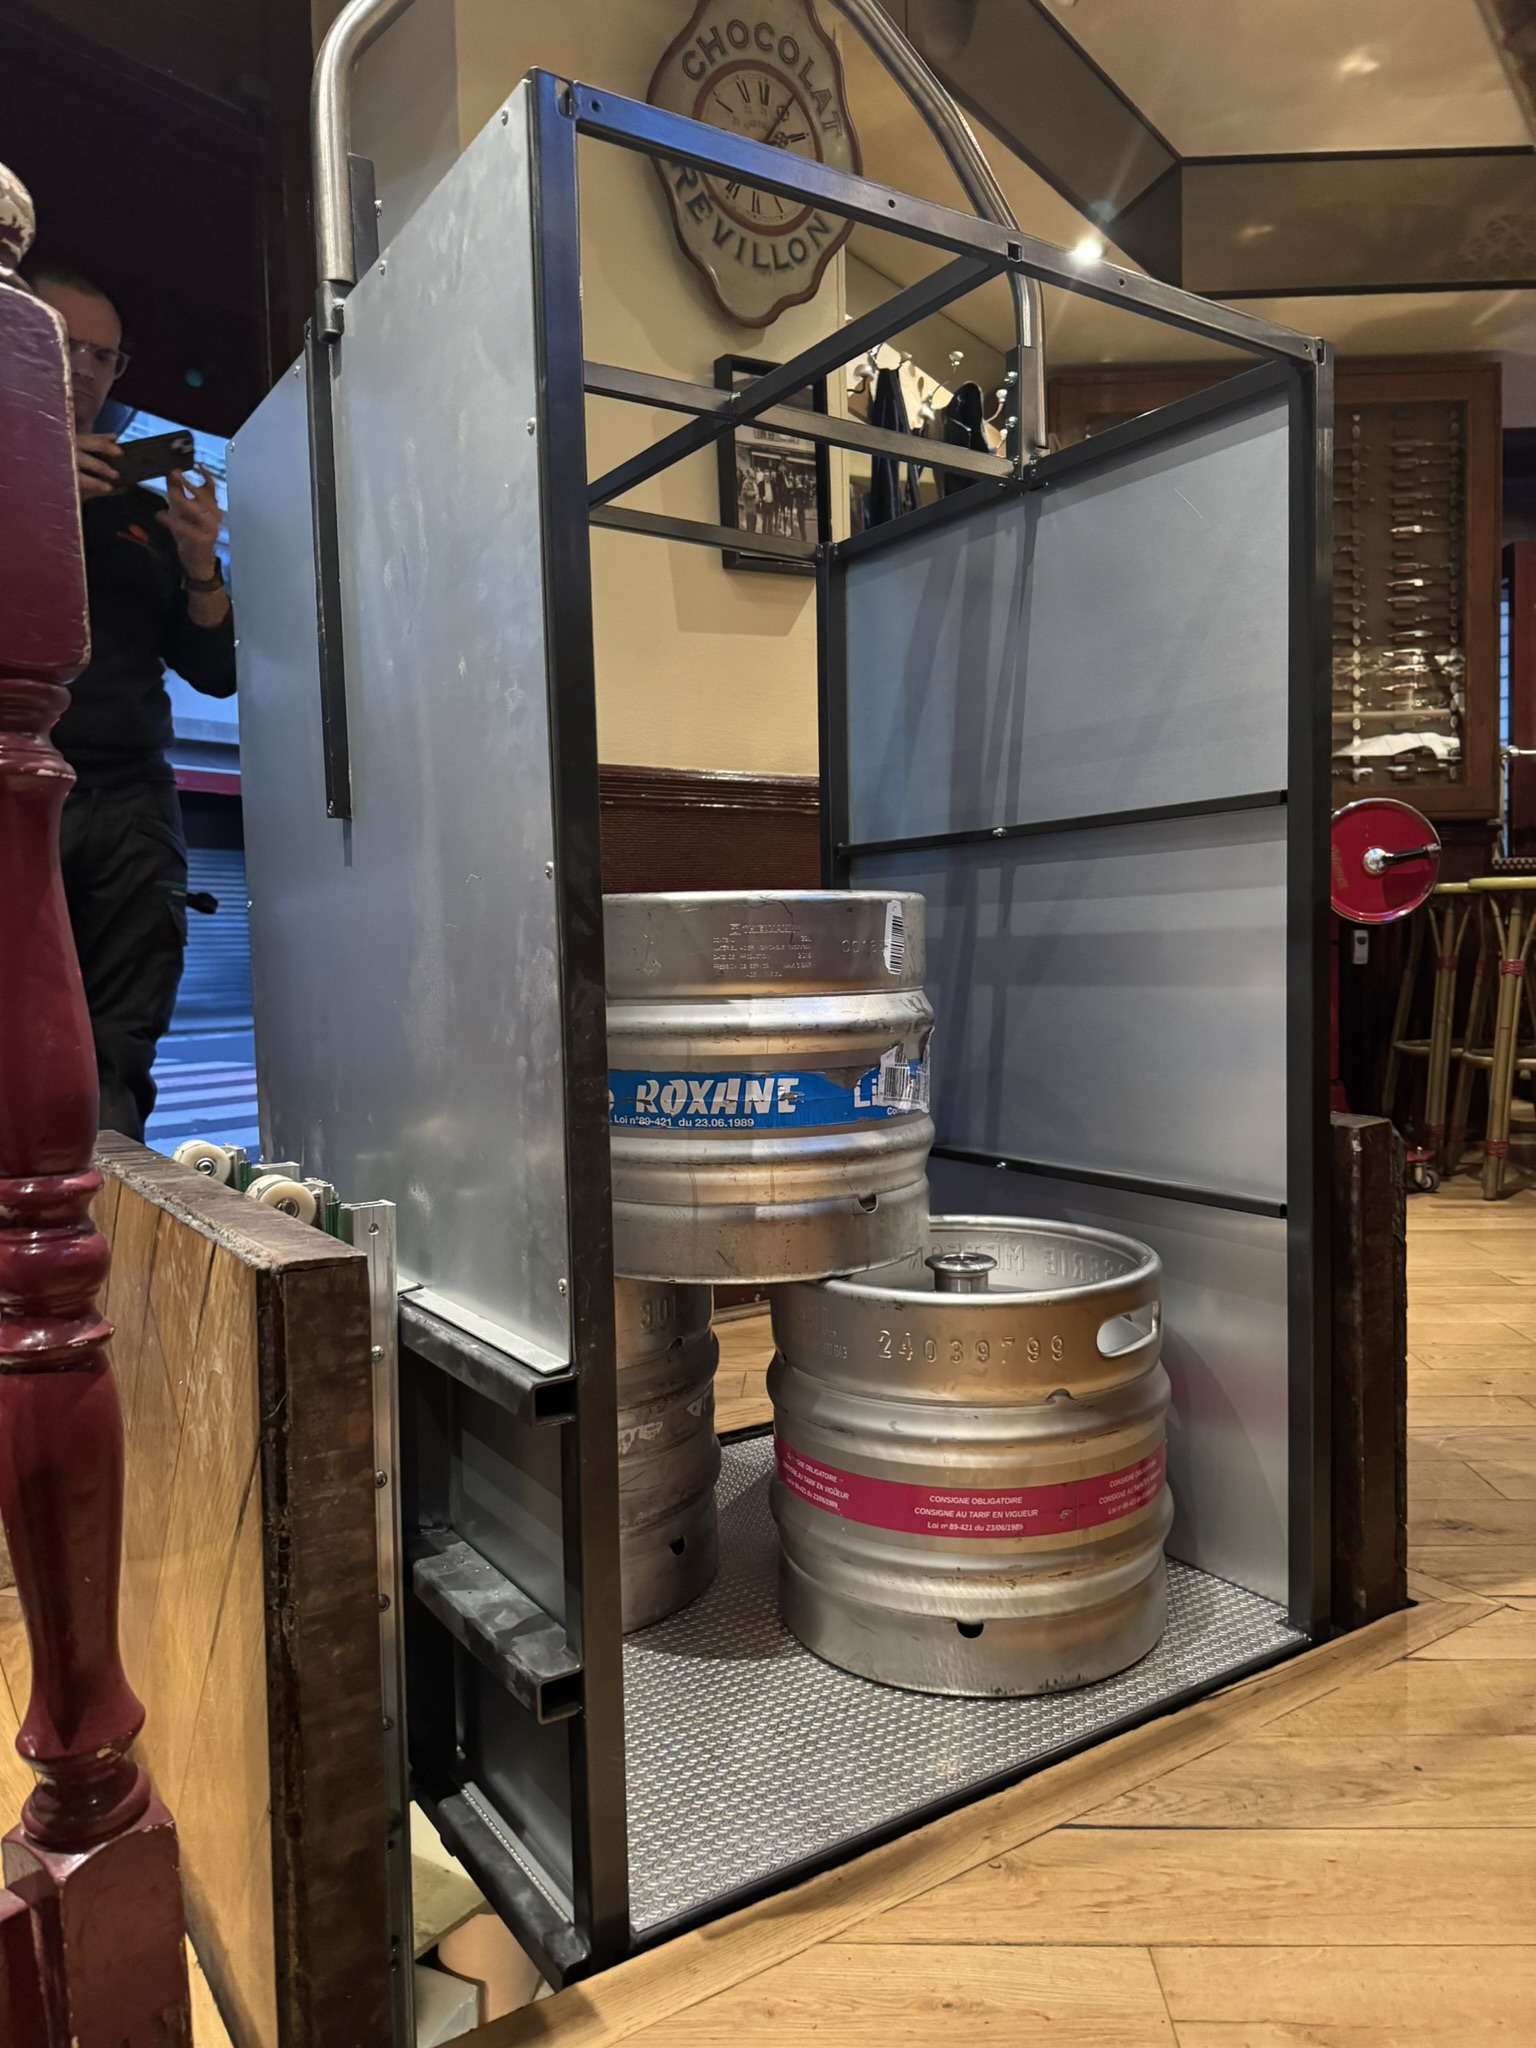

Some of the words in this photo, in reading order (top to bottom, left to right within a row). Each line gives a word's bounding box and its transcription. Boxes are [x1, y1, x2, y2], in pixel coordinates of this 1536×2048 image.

[682, 19, 843, 136] CHOCOLAT
[670, 164, 831, 271] REVILLON
[636, 1078, 800, 1115] ROXANE
[614, 1114, 628, 1124] Loi
[678, 1118, 692, 1127] du
[695, 1118, 754, 1128] 23.06.1989
[929, 1495, 970, 1505] CONSIGNE
[971, 1496, 1023, 1505] OBLIGATOIRE
[914, 1507, 954, 1518] CONSIGNE
[969, 1511, 991, 1519] TARIF
[992, 1511, 1003, 1519] EN
[1005, 1509, 1039, 1518] VIGUEUR
[927, 1521, 939, 1530] Loi
[949, 1523, 973, 1532] 89-421
[974, 1524, 984, 1532] du
